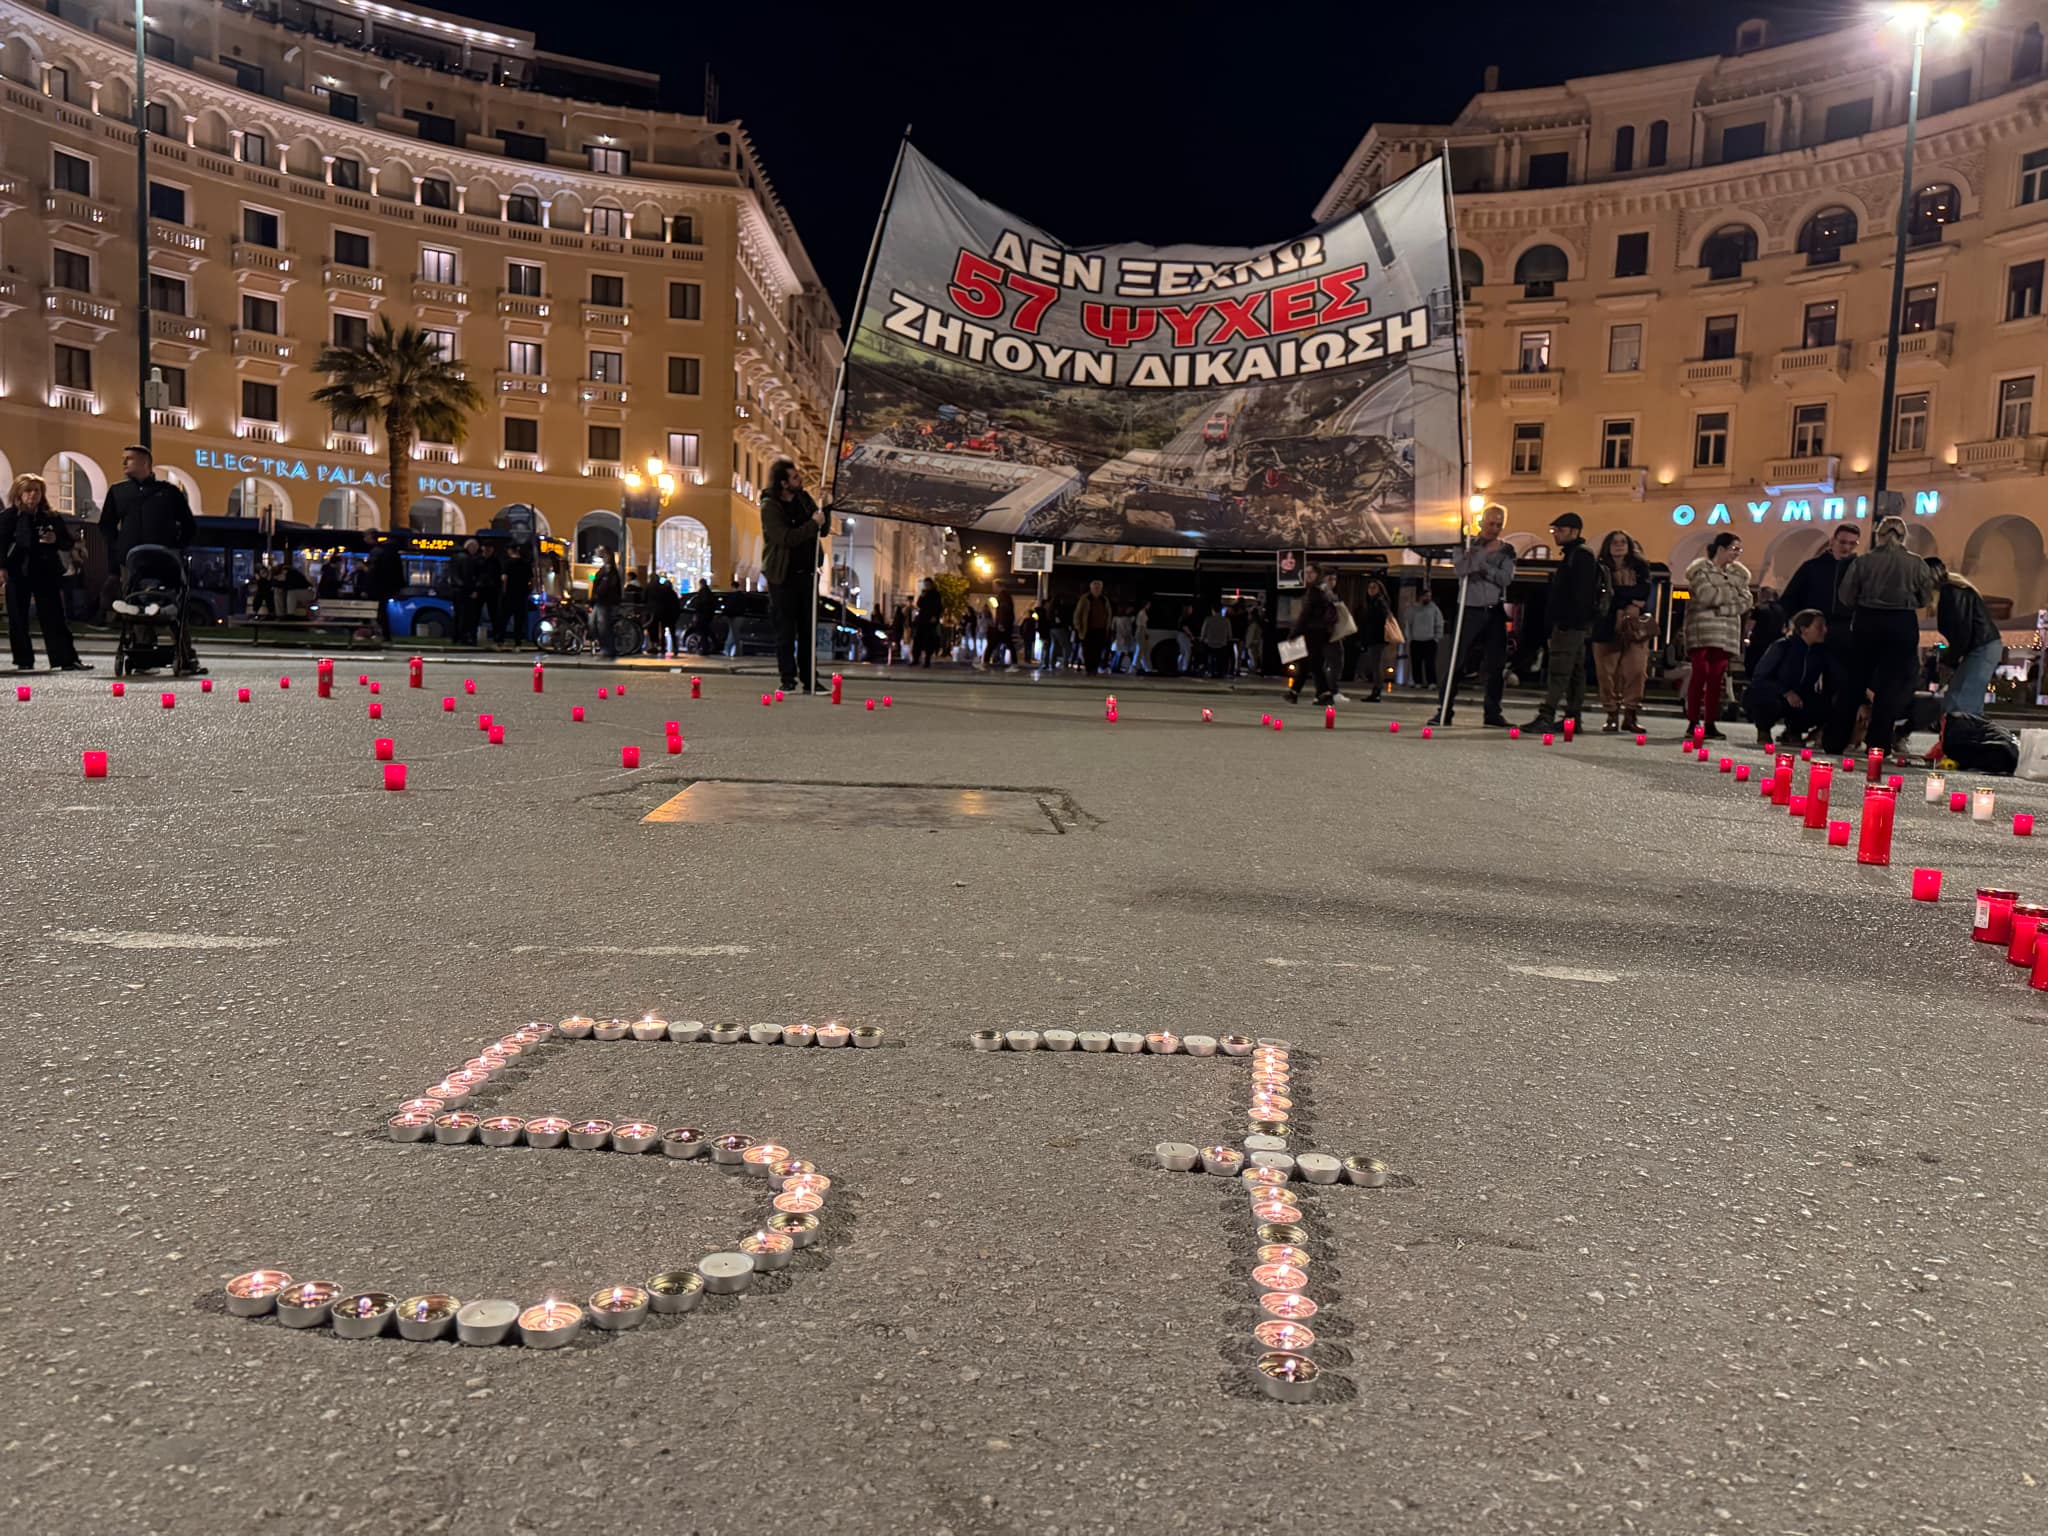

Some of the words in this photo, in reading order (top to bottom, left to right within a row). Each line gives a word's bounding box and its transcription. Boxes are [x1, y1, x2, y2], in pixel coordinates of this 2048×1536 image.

[993, 230, 1103, 293] ΔΕΝ
[1118, 235, 1324, 296] ΞΕΧΝΩ
[948, 249, 1059, 334] 57
[1082, 264, 1369, 347] ΨΥΧΕΣ
[884, 292, 1115, 386] ΖΗΤΟΥΝ
[1130, 308, 1429, 387] ΔΙΚΑΙΩΣΗ
[195, 449, 309, 480] ELECTRA
[317, 464, 392, 488] PALAC
[418, 476, 496, 498] HOTEL
[1672, 491, 1939, 526] ΟΛΥΜΠΙΝ
